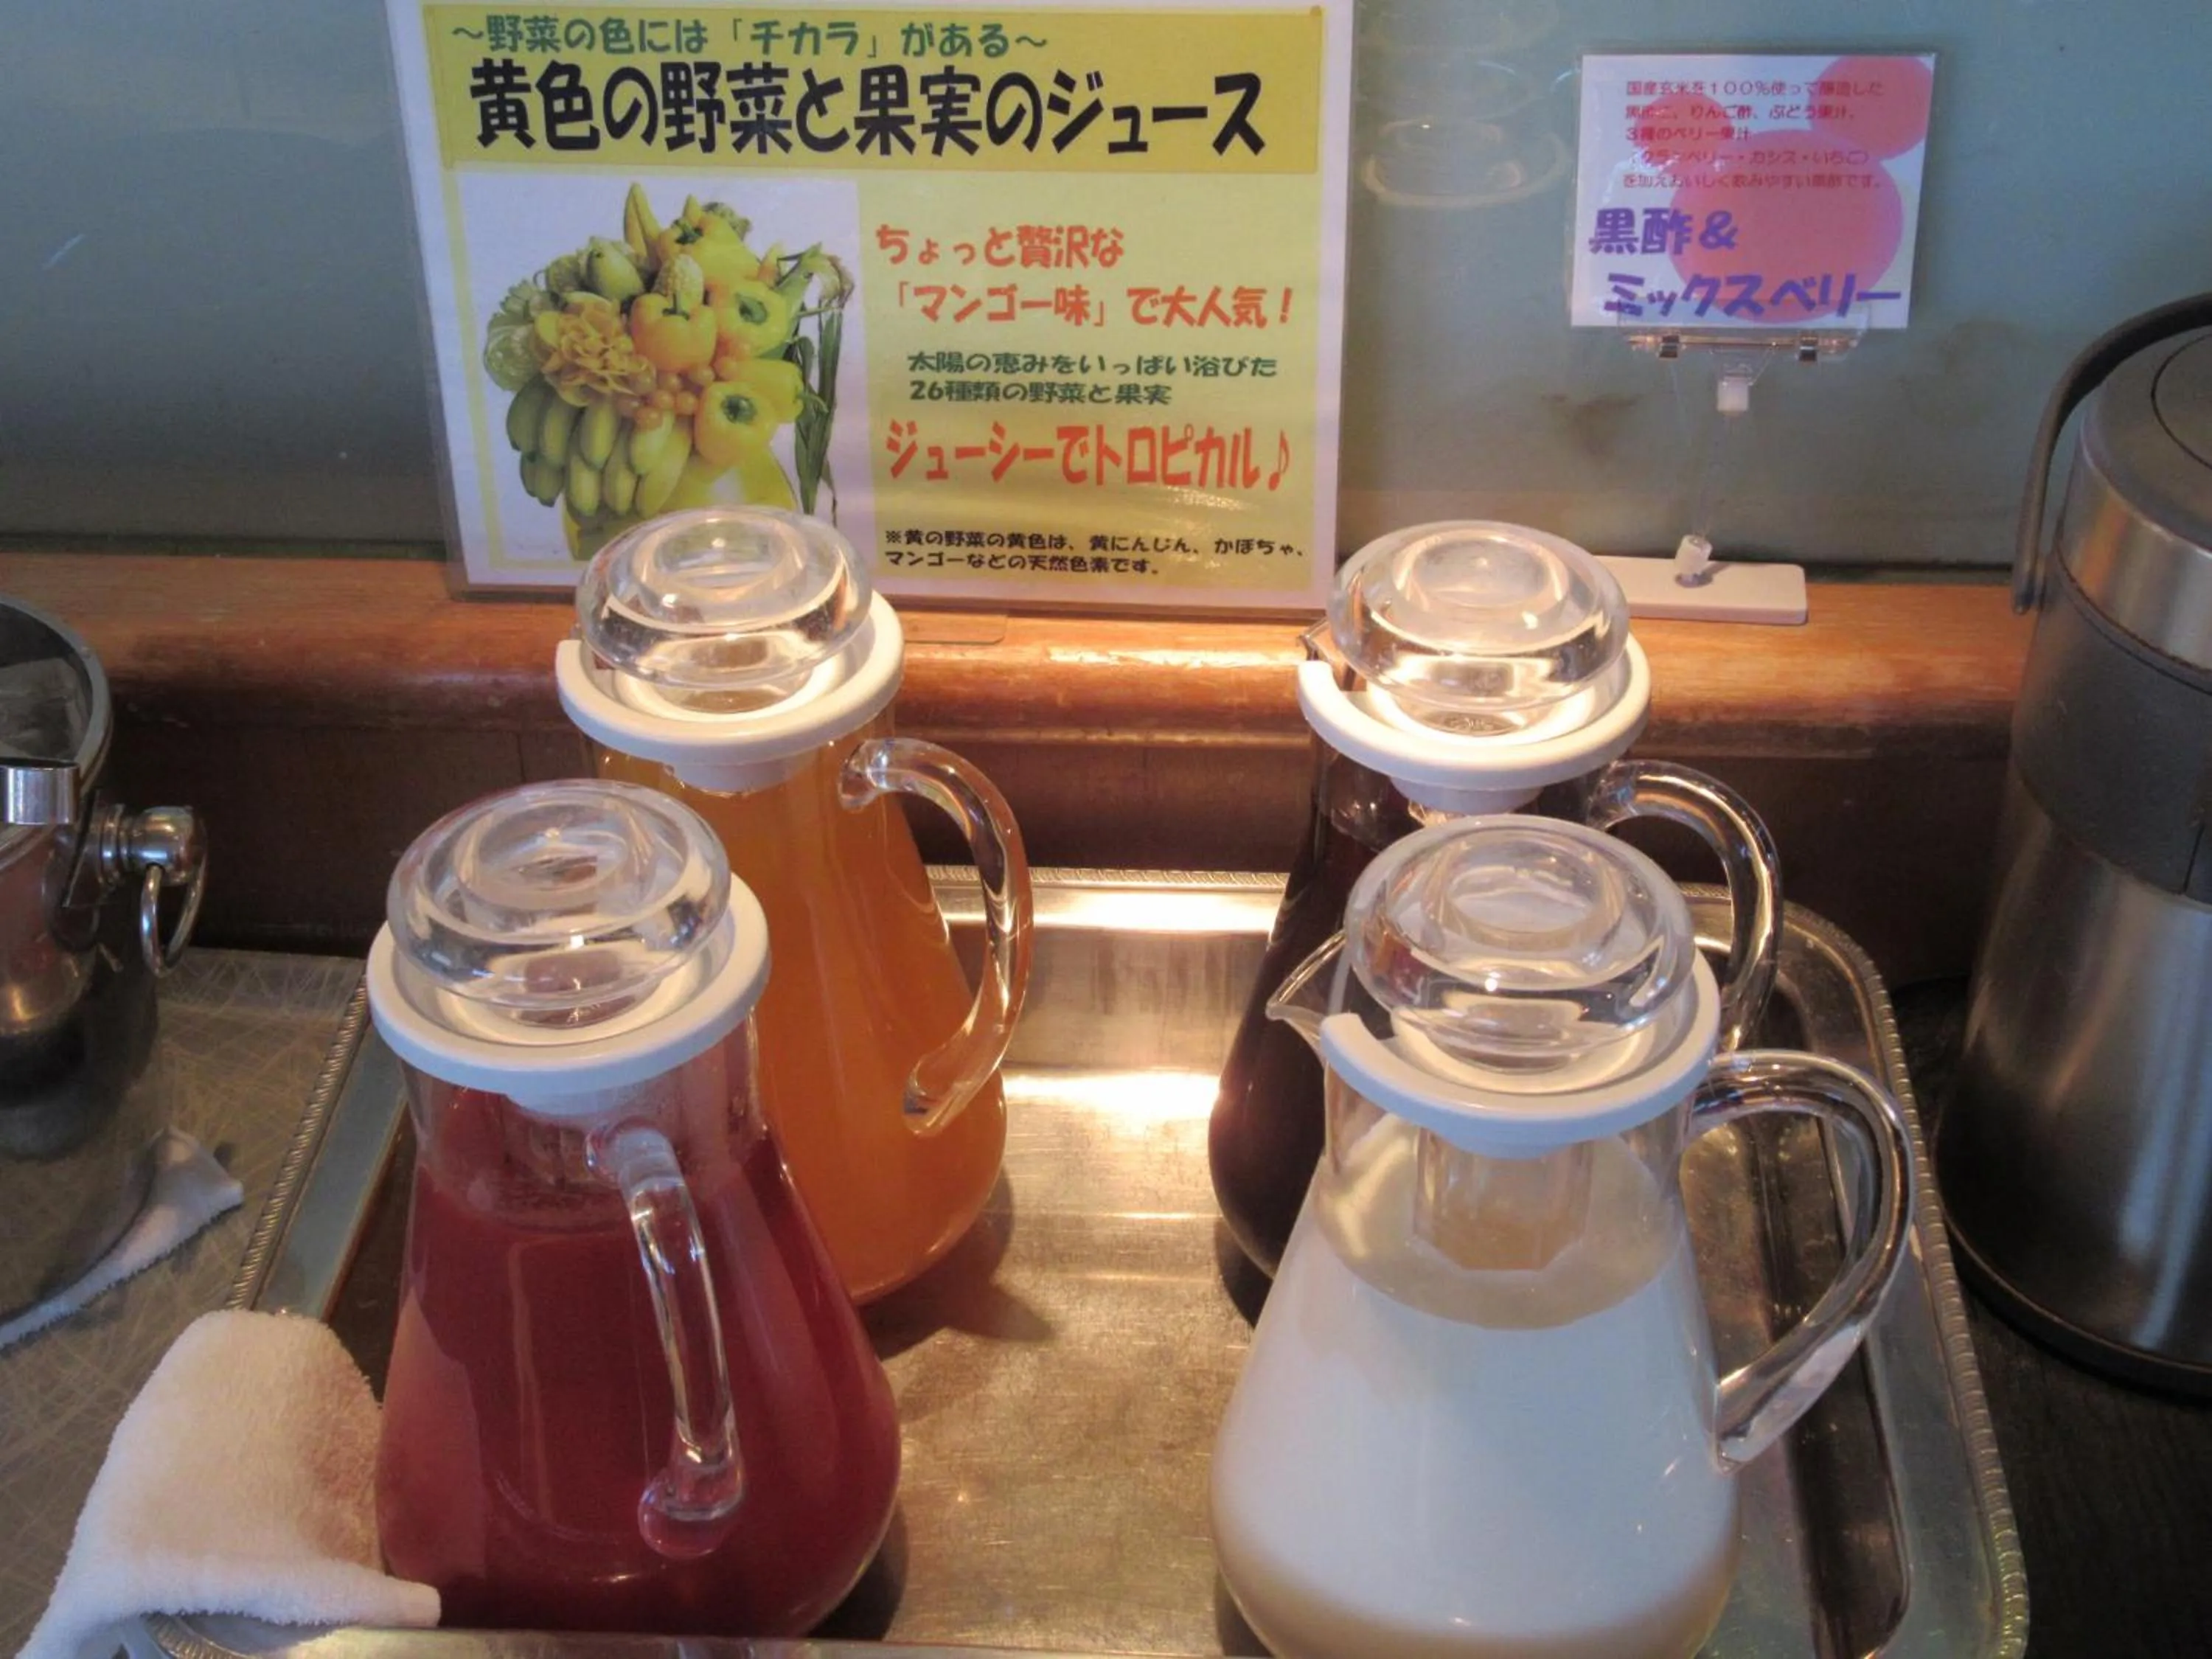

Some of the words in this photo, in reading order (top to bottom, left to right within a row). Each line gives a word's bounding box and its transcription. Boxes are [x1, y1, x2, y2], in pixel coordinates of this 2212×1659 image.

[470, 58, 1265, 156] 黄色の野菜と果実のジュース
[876, 224, 1124, 268] ちょっと贅沢な
[1588, 207, 1738, 255] 黒酢&
[898, 281, 1293, 329] 「マンゴー味」で大人気！
[1603, 273, 1901, 318] ミックスベリー
[907, 351, 1277, 378] 太陽の恵みをいっぱい浴びた
[910, 380, 1172, 405] 26種類の野菜と果実
[885, 552, 1160, 576] マンゴーなどの天然色素です。
